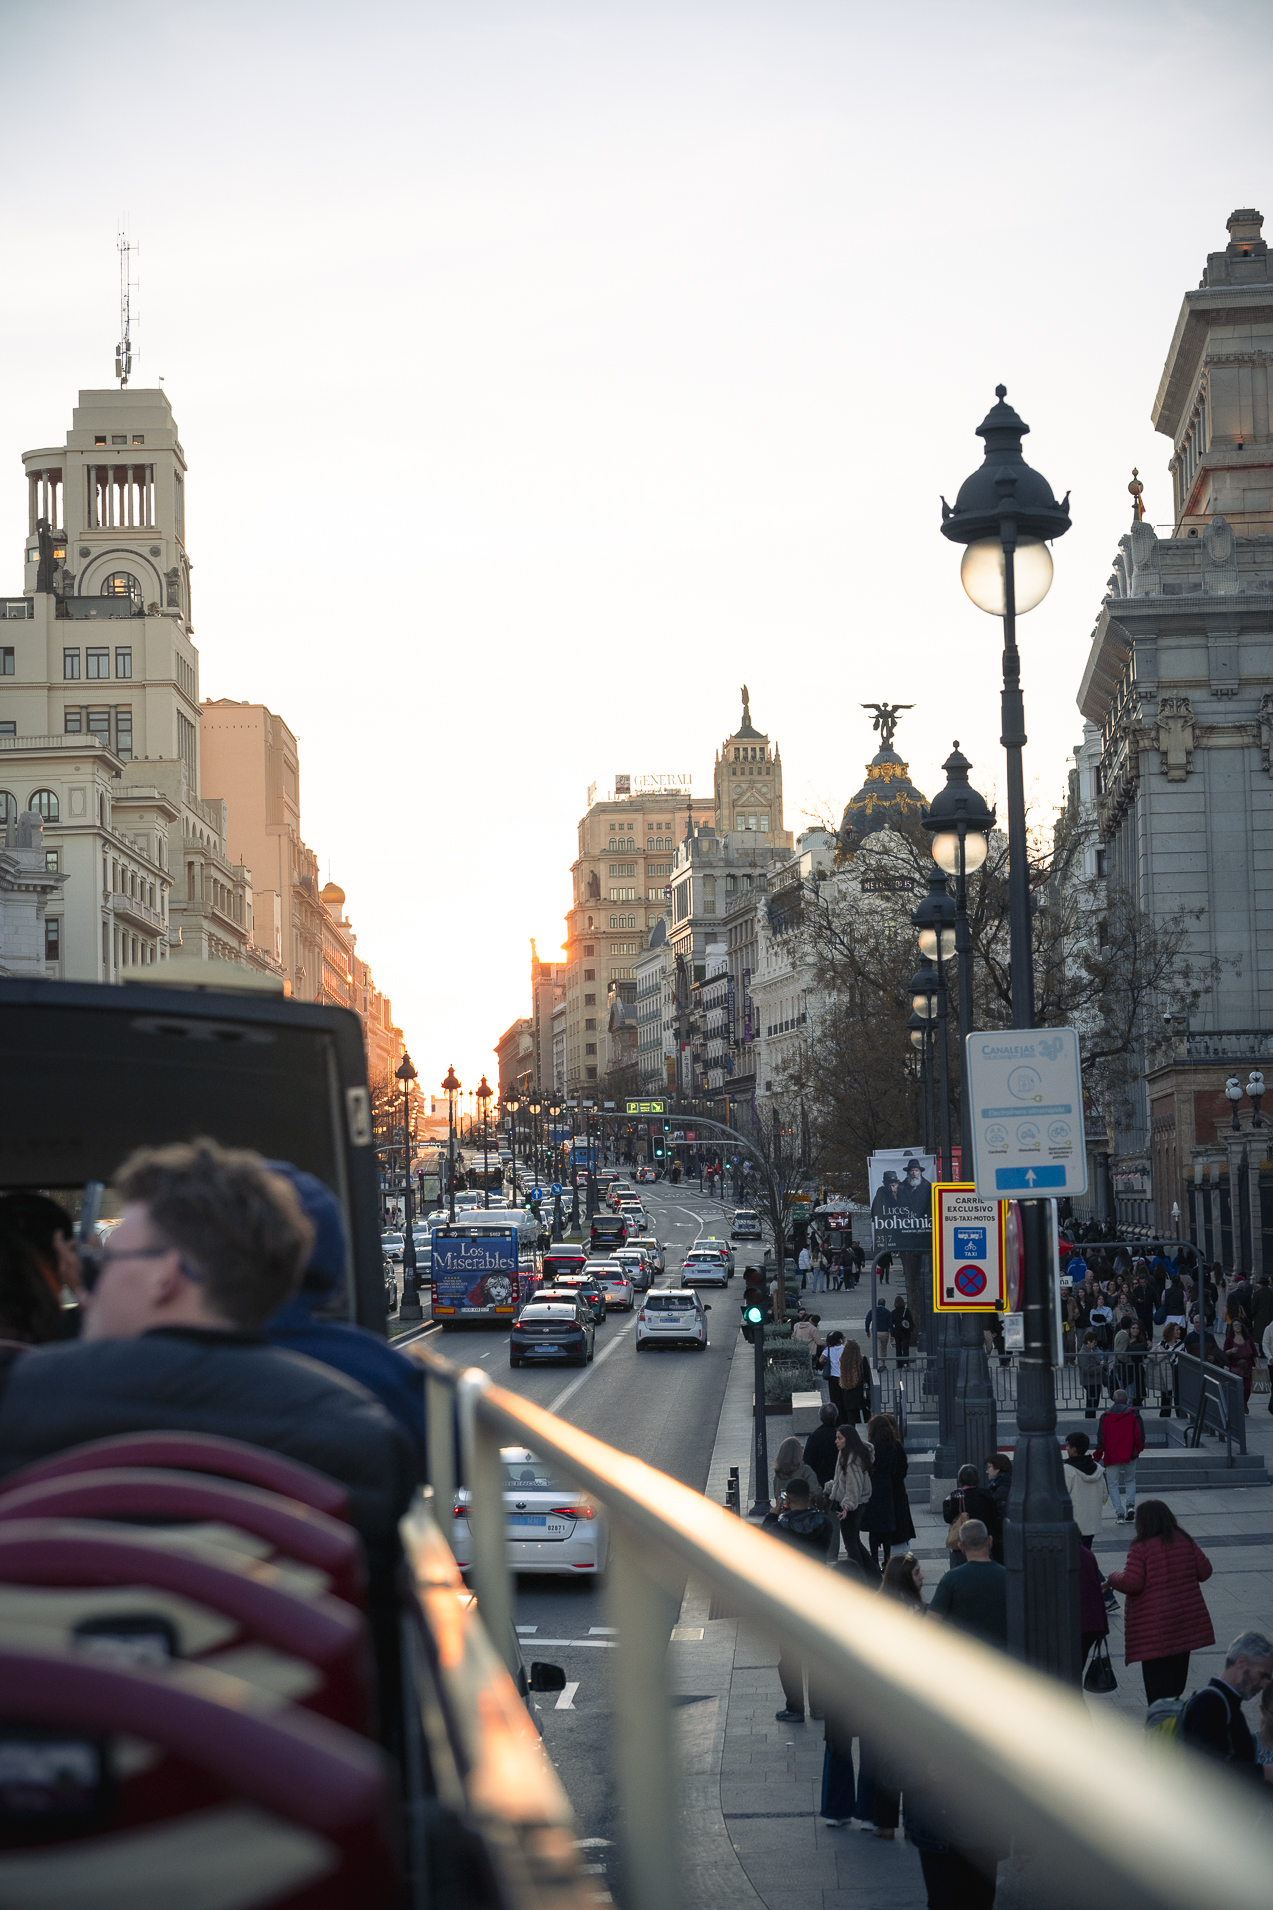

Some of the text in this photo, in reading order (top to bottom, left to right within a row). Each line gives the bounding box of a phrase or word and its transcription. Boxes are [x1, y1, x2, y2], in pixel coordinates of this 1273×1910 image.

[634, 774, 692, 786] GENERALI
[981, 1045, 1036, 1056] CANALEJAS
[882, 1205, 910, 1215] Luces
[907, 1211, 917, 1219] de
[875, 1214, 932, 1229] bohemia
[876, 1235, 885, 1243] 23
[460, 1243, 484, 1257] Los
[433, 1251, 515, 1270] Miserables
